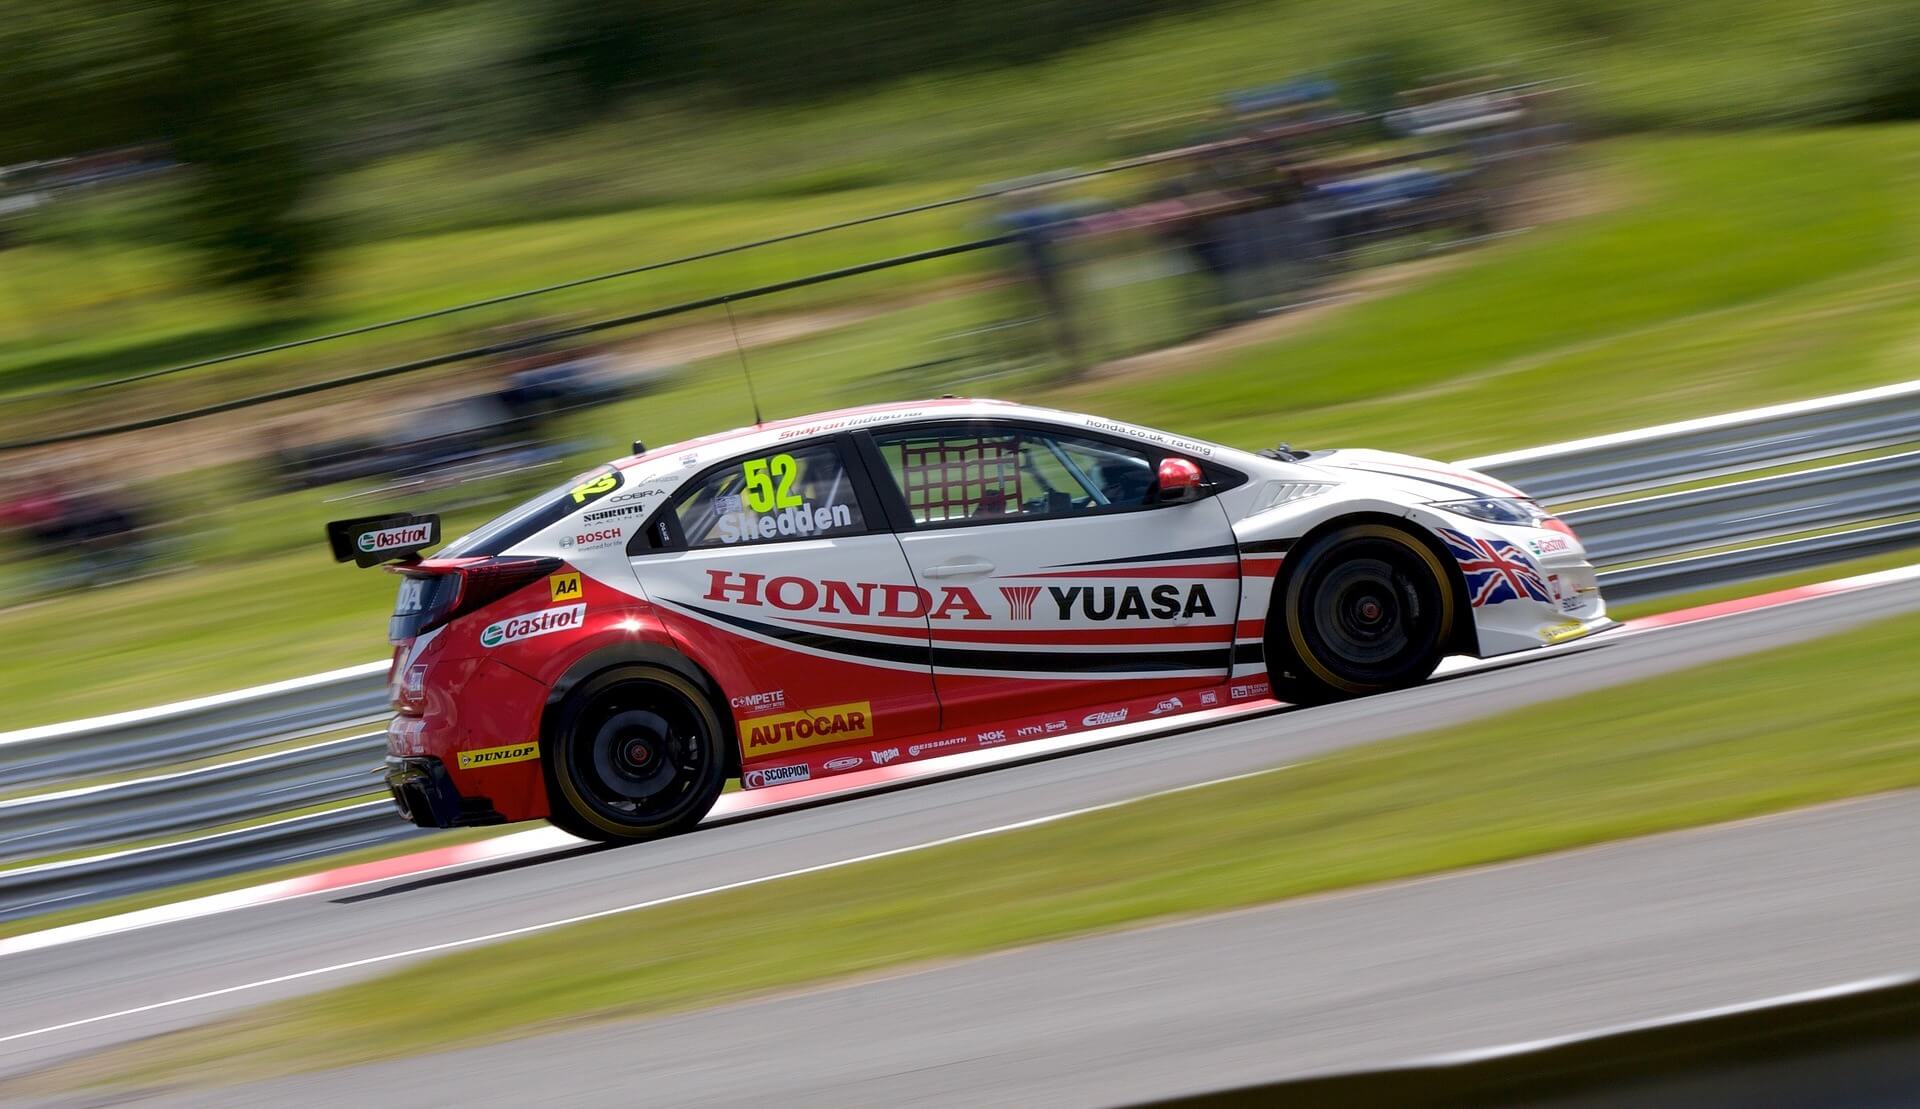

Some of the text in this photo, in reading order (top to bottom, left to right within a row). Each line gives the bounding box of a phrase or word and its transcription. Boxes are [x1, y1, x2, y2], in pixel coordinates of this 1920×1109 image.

[742, 454, 803, 513] 52
[610, 489, 665, 502] COBRA
[584, 505, 643, 523] SCHROTH
[720, 503, 851, 544] Shedden
[376, 525, 427, 548] Castrol
[576, 528, 621, 545] BOSCH
[555, 578, 578, 595] AA
[703, 569, 1216, 620] HONDA YUASA
[504, 607, 578, 639] Castrol
[750, 712, 866, 748] AUTOCAR
[978, 729, 1005, 741] NGK
[1017, 725, 1042, 736] NTN
[474, 747, 534, 763] DUNLOP
[764, 765, 809, 781] SCORPION
